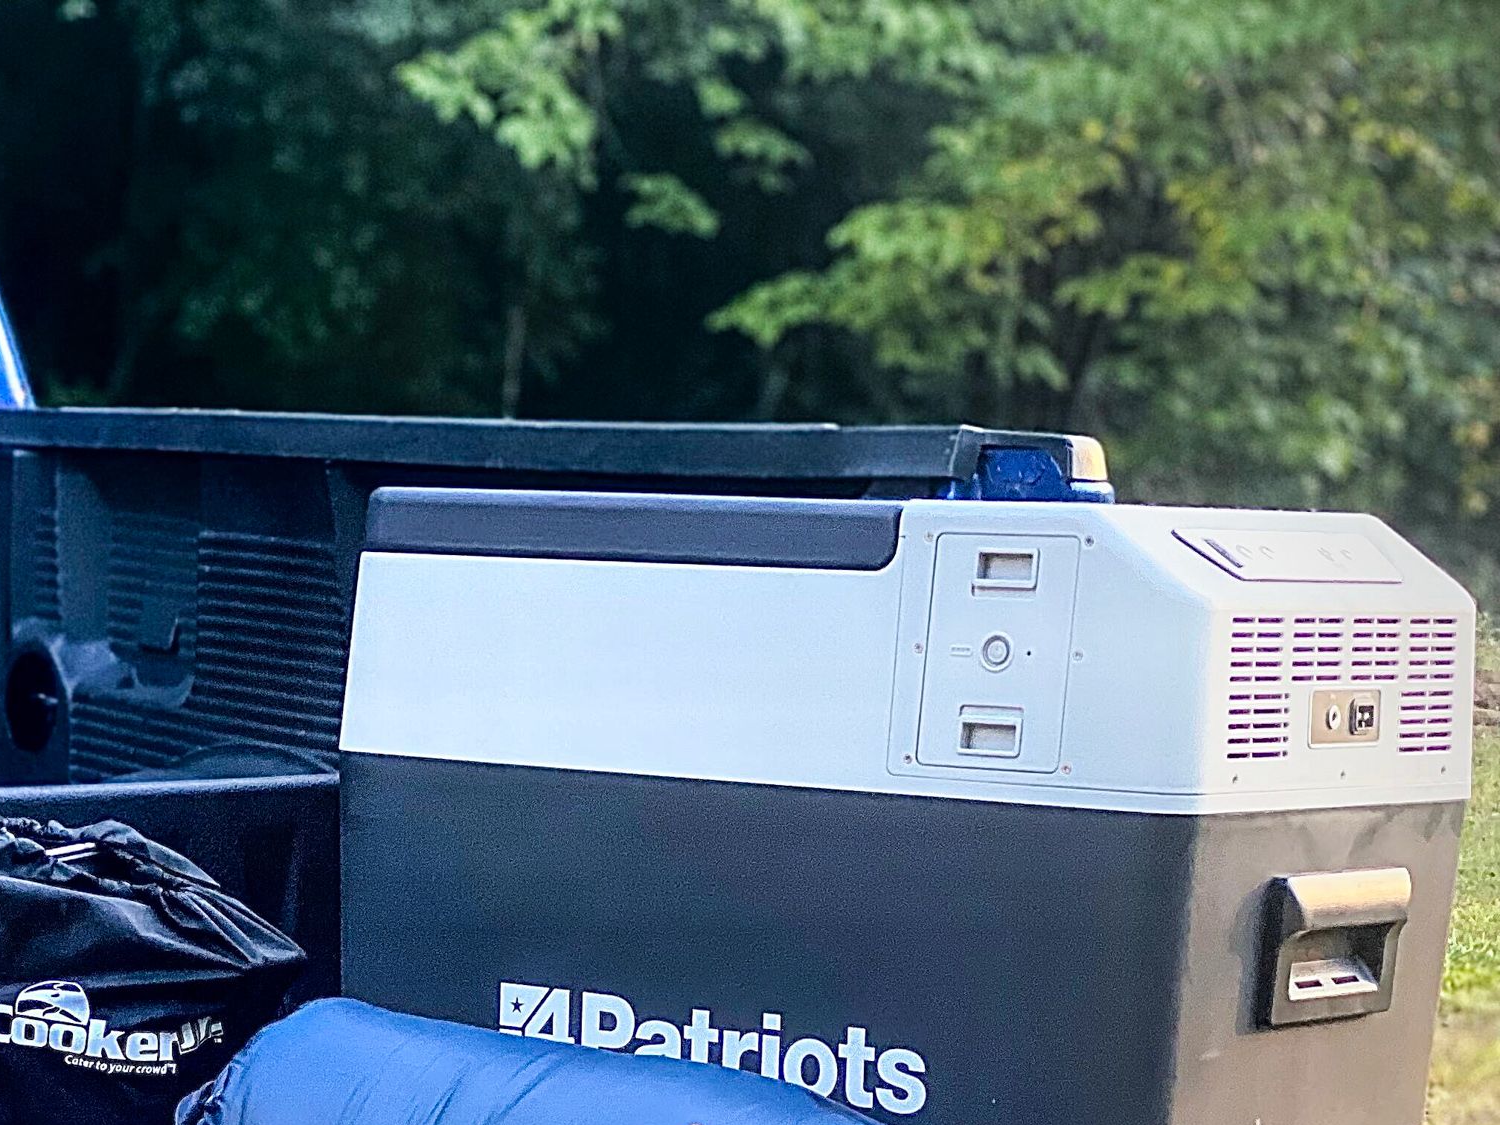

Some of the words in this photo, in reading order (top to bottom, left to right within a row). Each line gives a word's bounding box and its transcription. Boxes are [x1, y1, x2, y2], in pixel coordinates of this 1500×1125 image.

[64, 1054, 95, 1069] Cater
[95, 1060, 108, 1073] to
[108, 1062, 135, 1074] your
